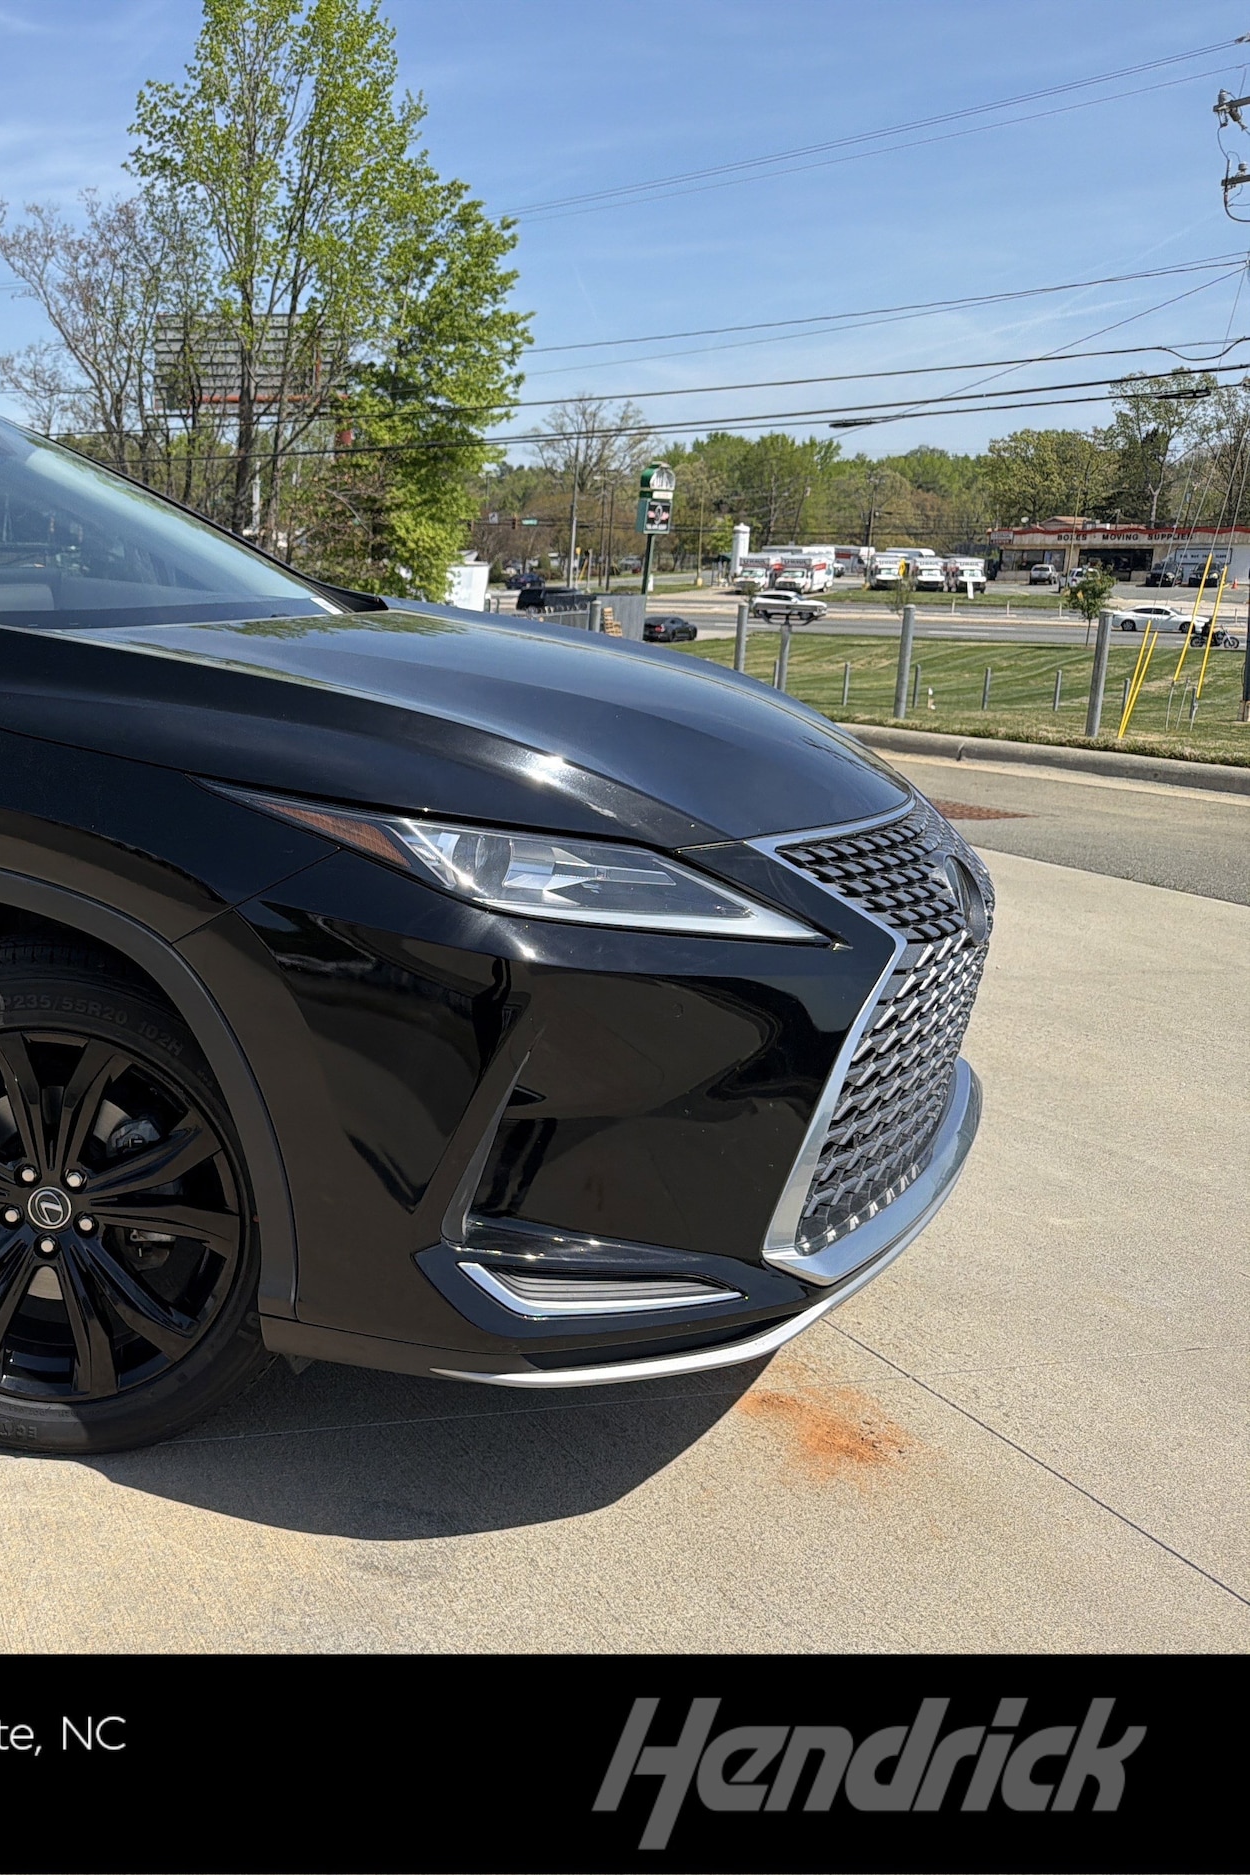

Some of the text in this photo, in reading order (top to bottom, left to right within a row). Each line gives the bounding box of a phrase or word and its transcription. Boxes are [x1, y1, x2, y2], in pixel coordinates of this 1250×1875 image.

[1102, 533, 1139, 541] MOVING
[1147, 533, 1193, 541] SUPPLIES
[4, 994, 185, 1057] P235/55R20 102H
